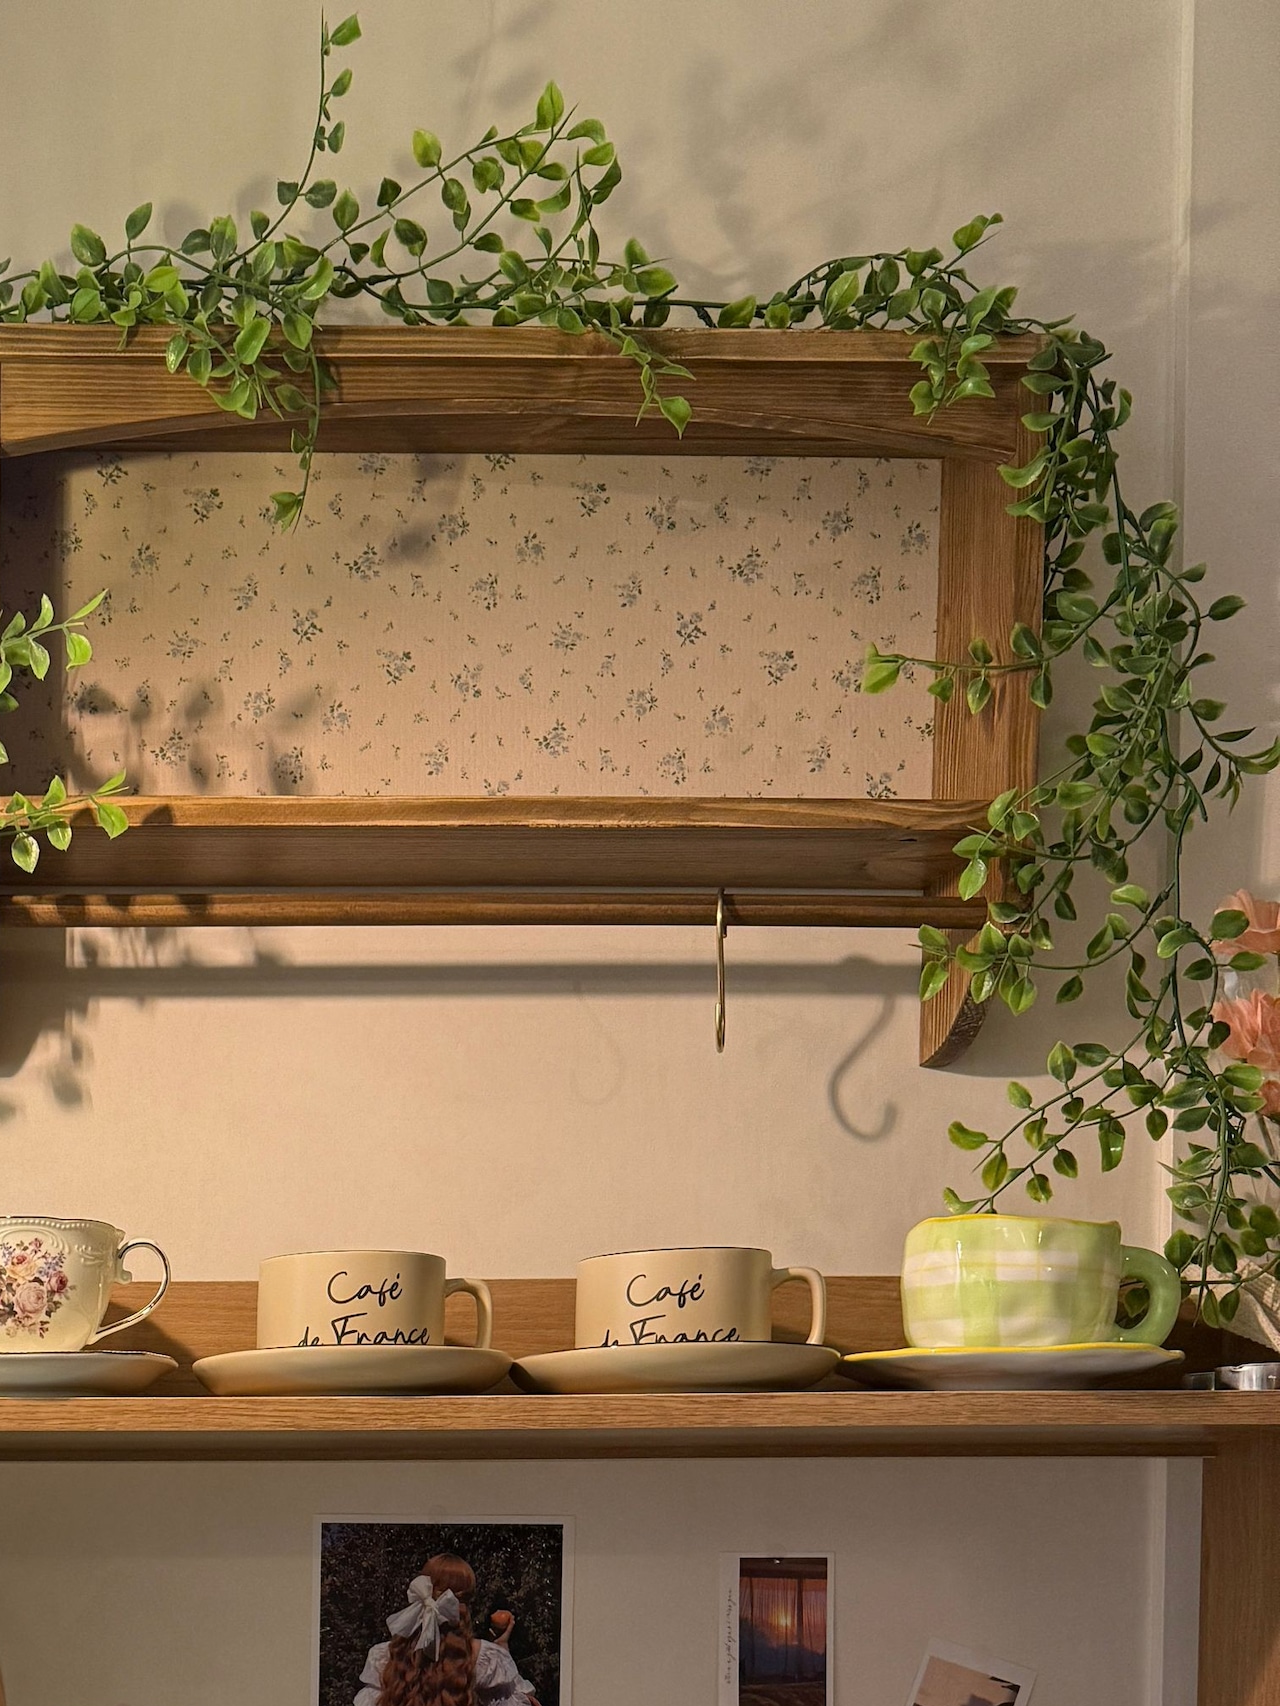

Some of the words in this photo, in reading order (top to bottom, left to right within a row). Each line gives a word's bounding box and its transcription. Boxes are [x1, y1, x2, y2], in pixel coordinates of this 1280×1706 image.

[327, 1271, 403, 1307] Café
[627, 1274, 704, 1308] Café
[331, 1312, 430, 1345] France
[630, 1315, 740, 1344] France
